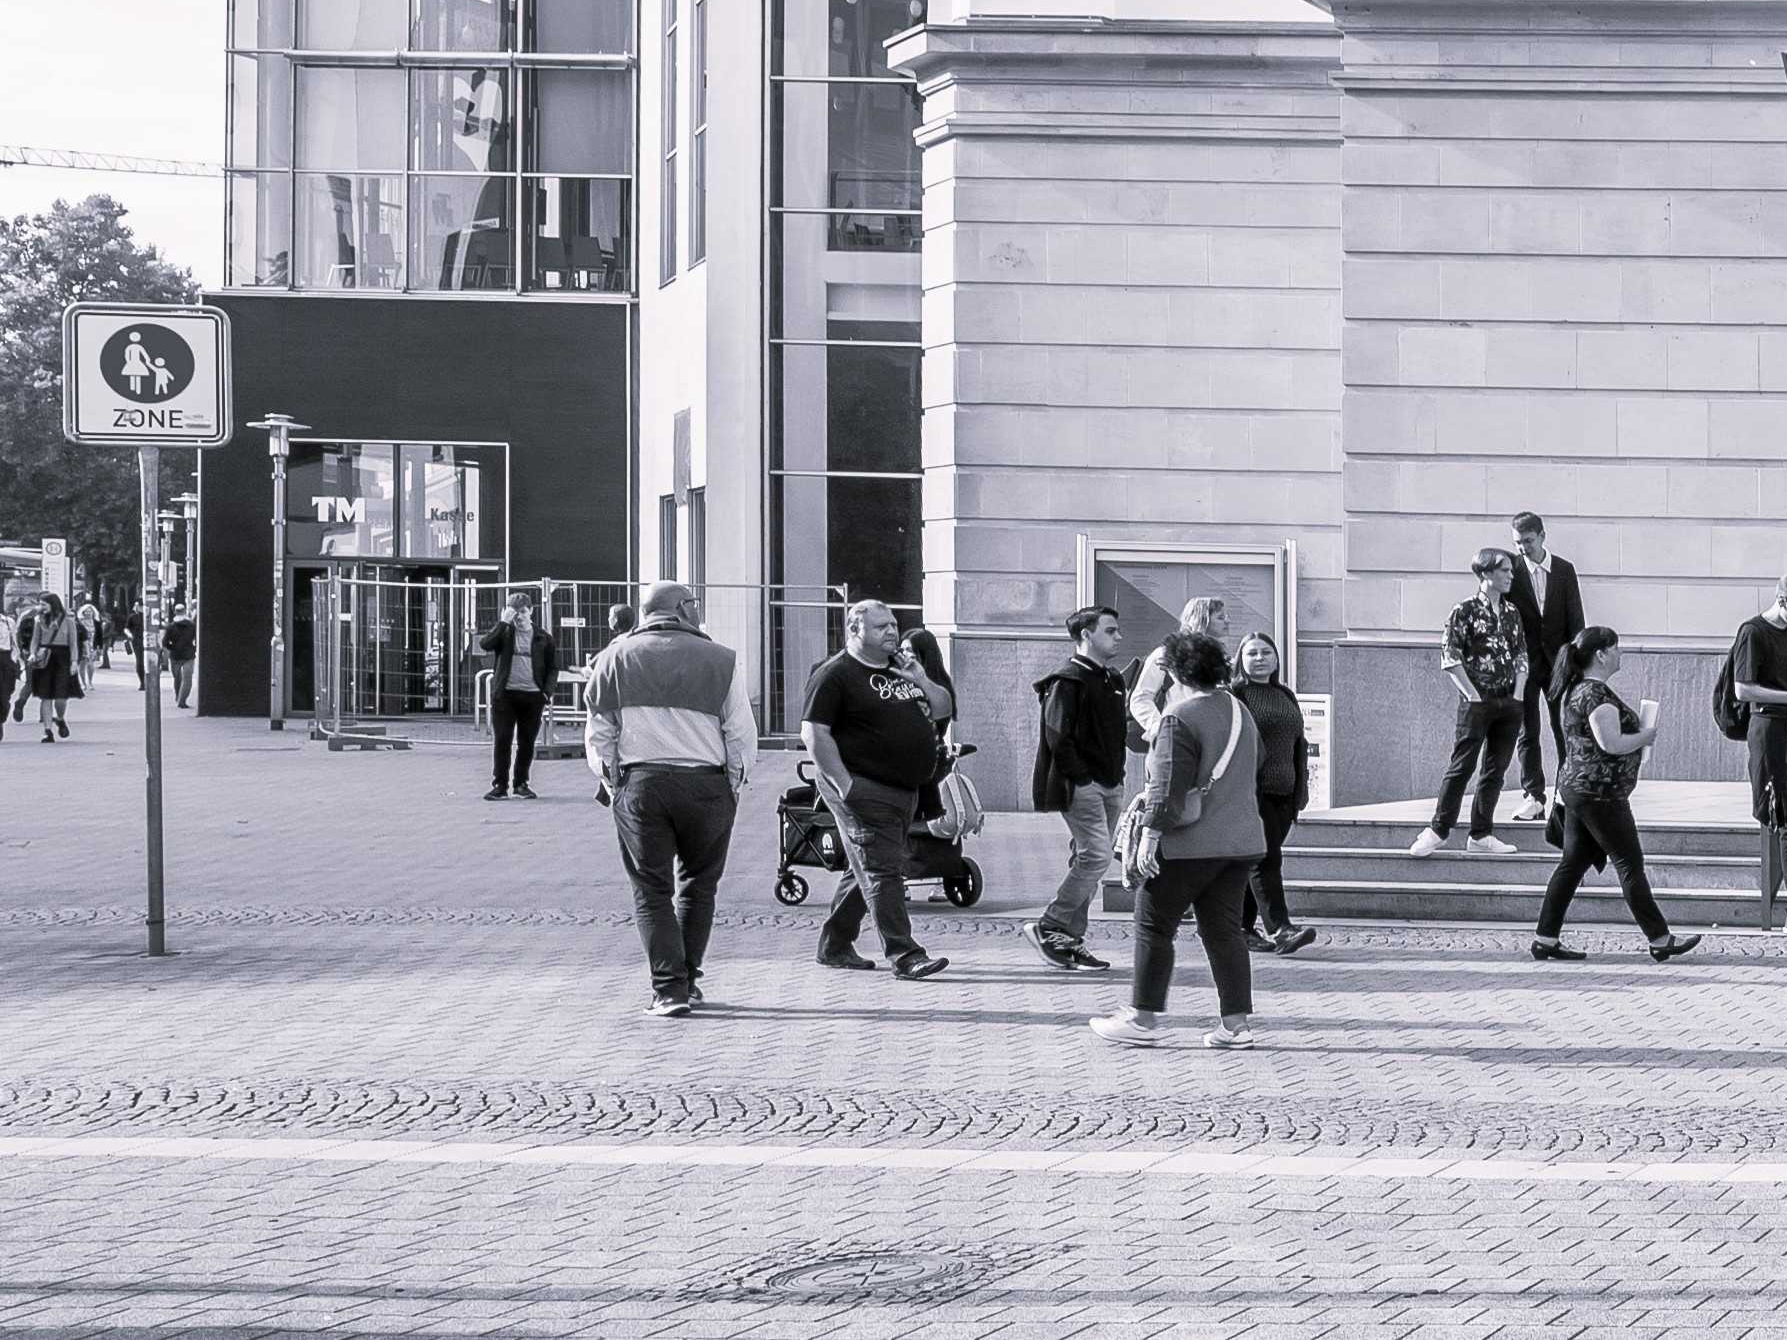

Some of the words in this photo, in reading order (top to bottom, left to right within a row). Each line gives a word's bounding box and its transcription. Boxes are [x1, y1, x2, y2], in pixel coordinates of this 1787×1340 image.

[113, 408, 183, 429] ZONE
[311, 496, 366, 523] TM
[430, 507, 475, 523] Kase
